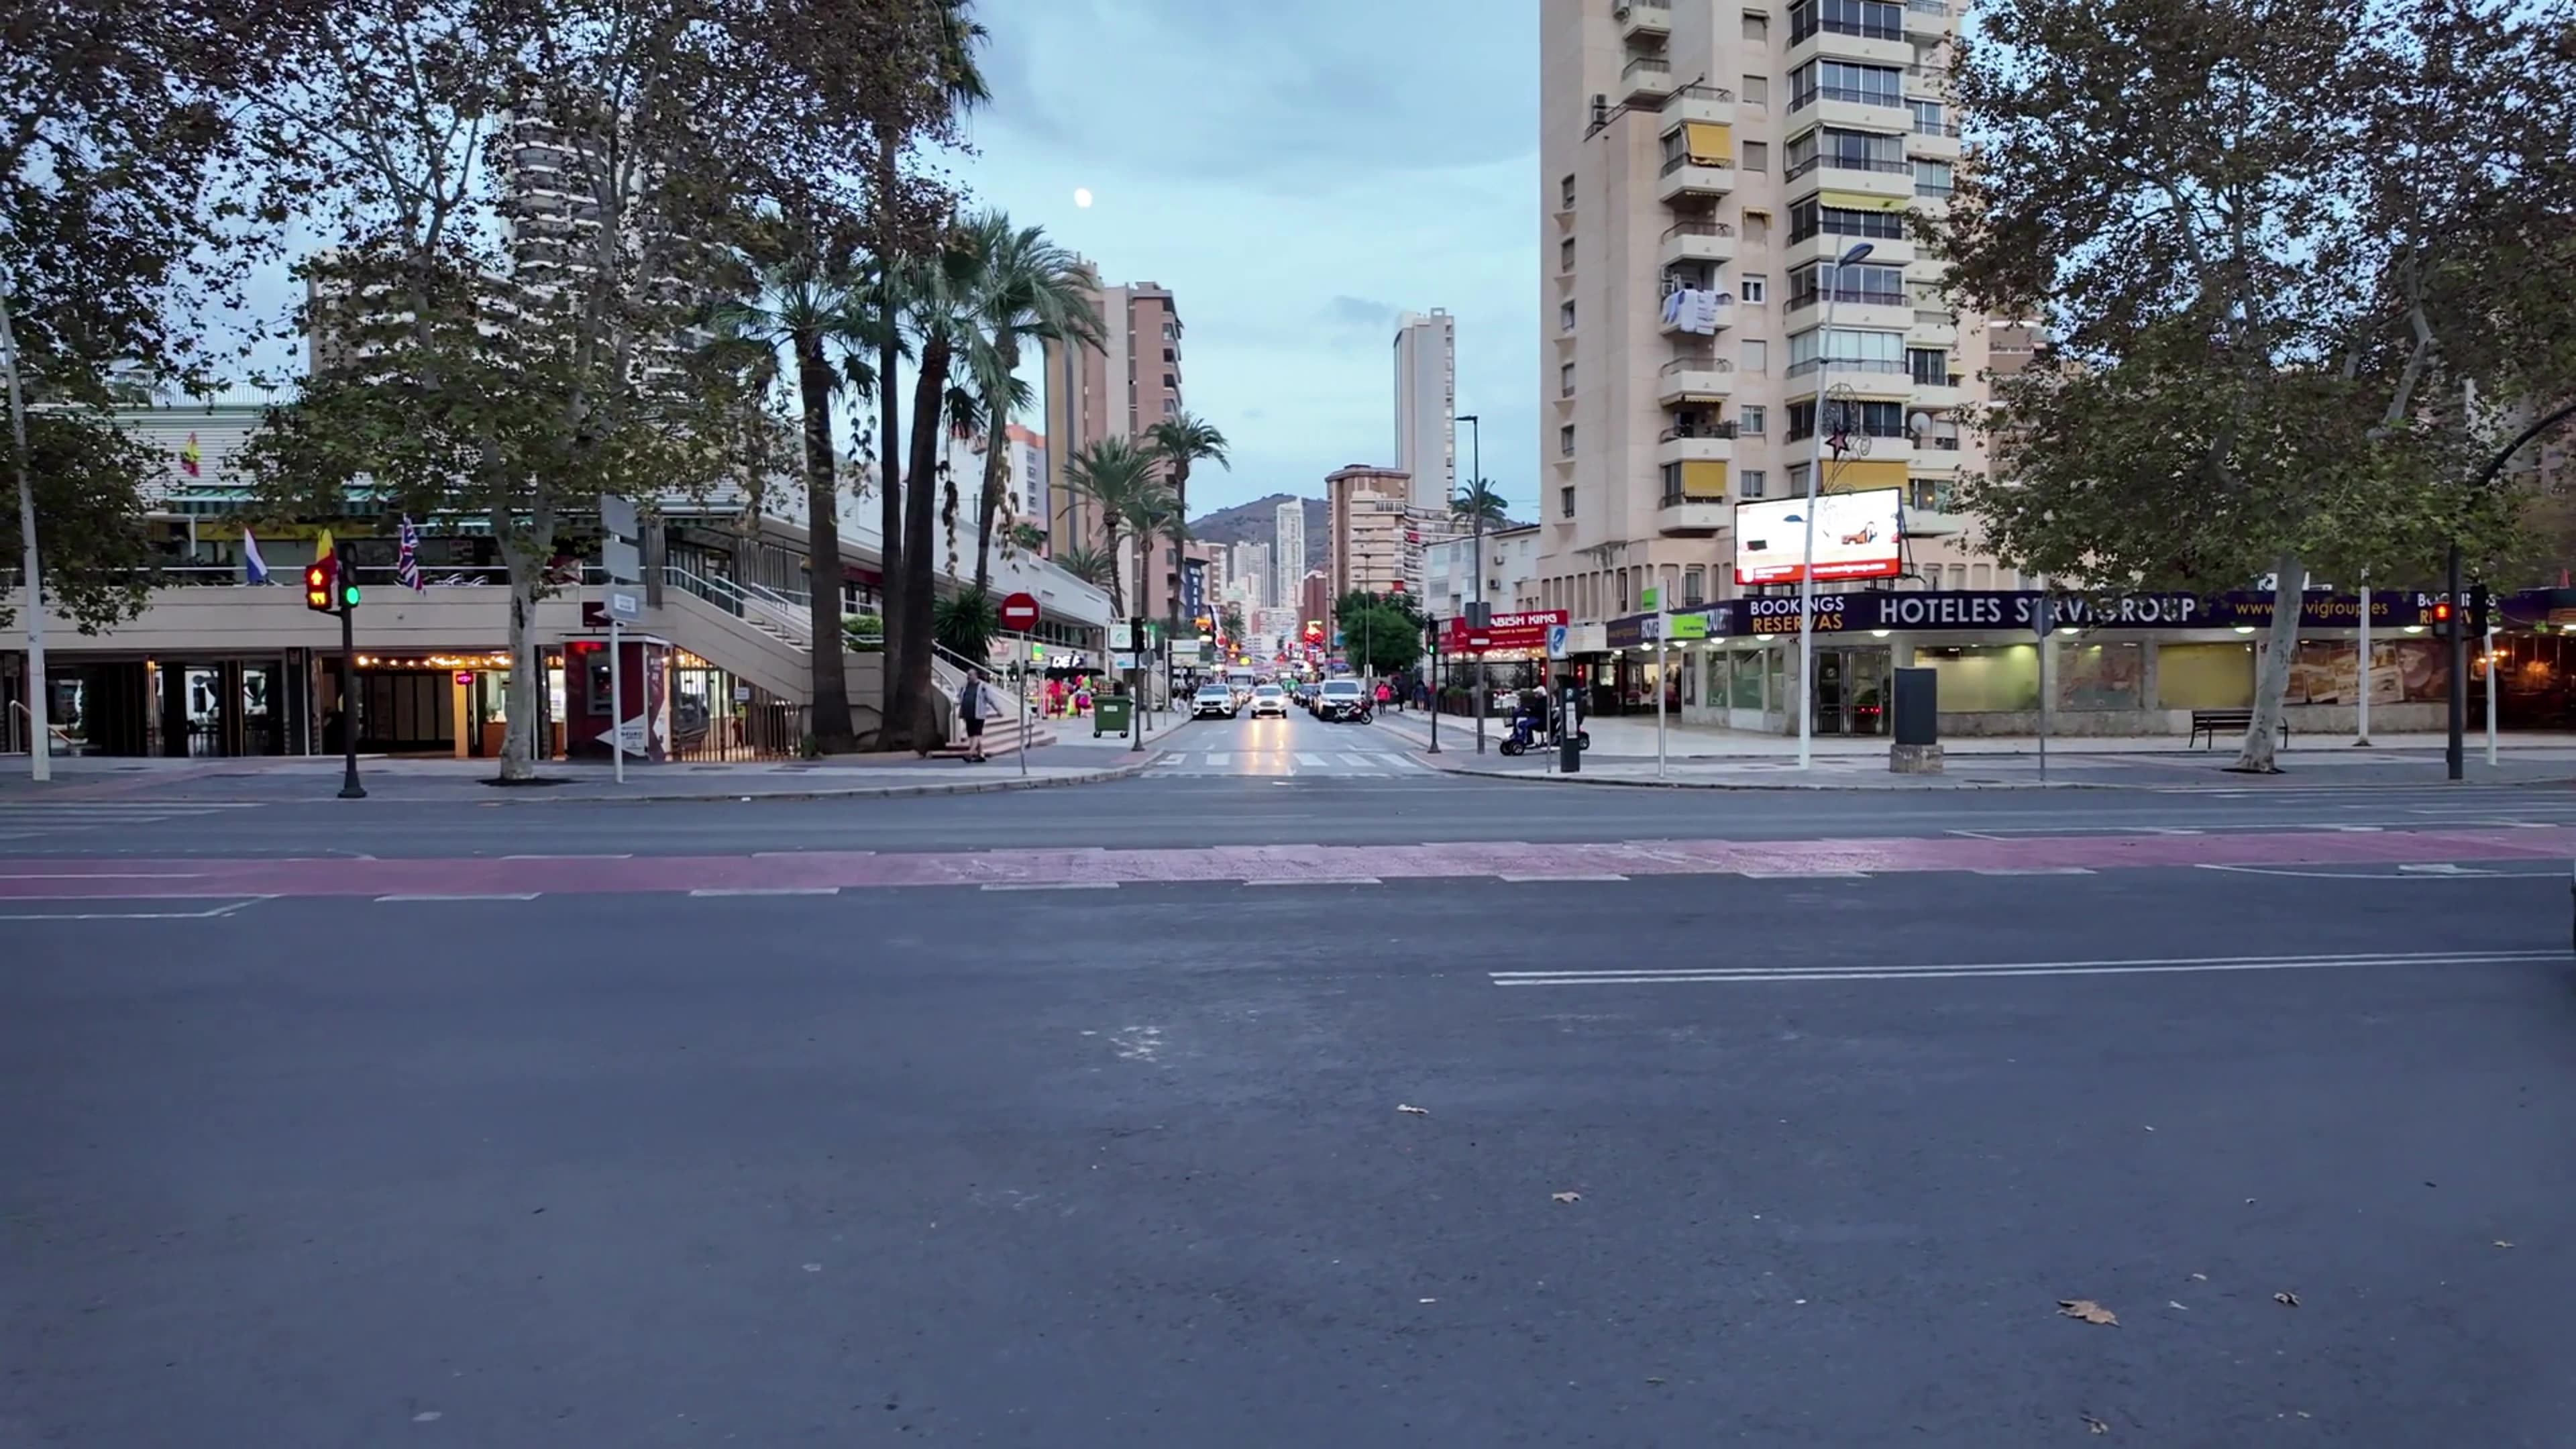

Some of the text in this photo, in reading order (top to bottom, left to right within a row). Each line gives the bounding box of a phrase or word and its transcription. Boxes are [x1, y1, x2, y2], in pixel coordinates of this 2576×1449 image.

[1750, 596, 1845, 615] BOOKNGS
[1880, 597, 2196, 623] HOTELES SRVIGROUP
[2235, 598, 2389, 619] wwwvigroupes
[1527, 612, 1558, 625] KING
